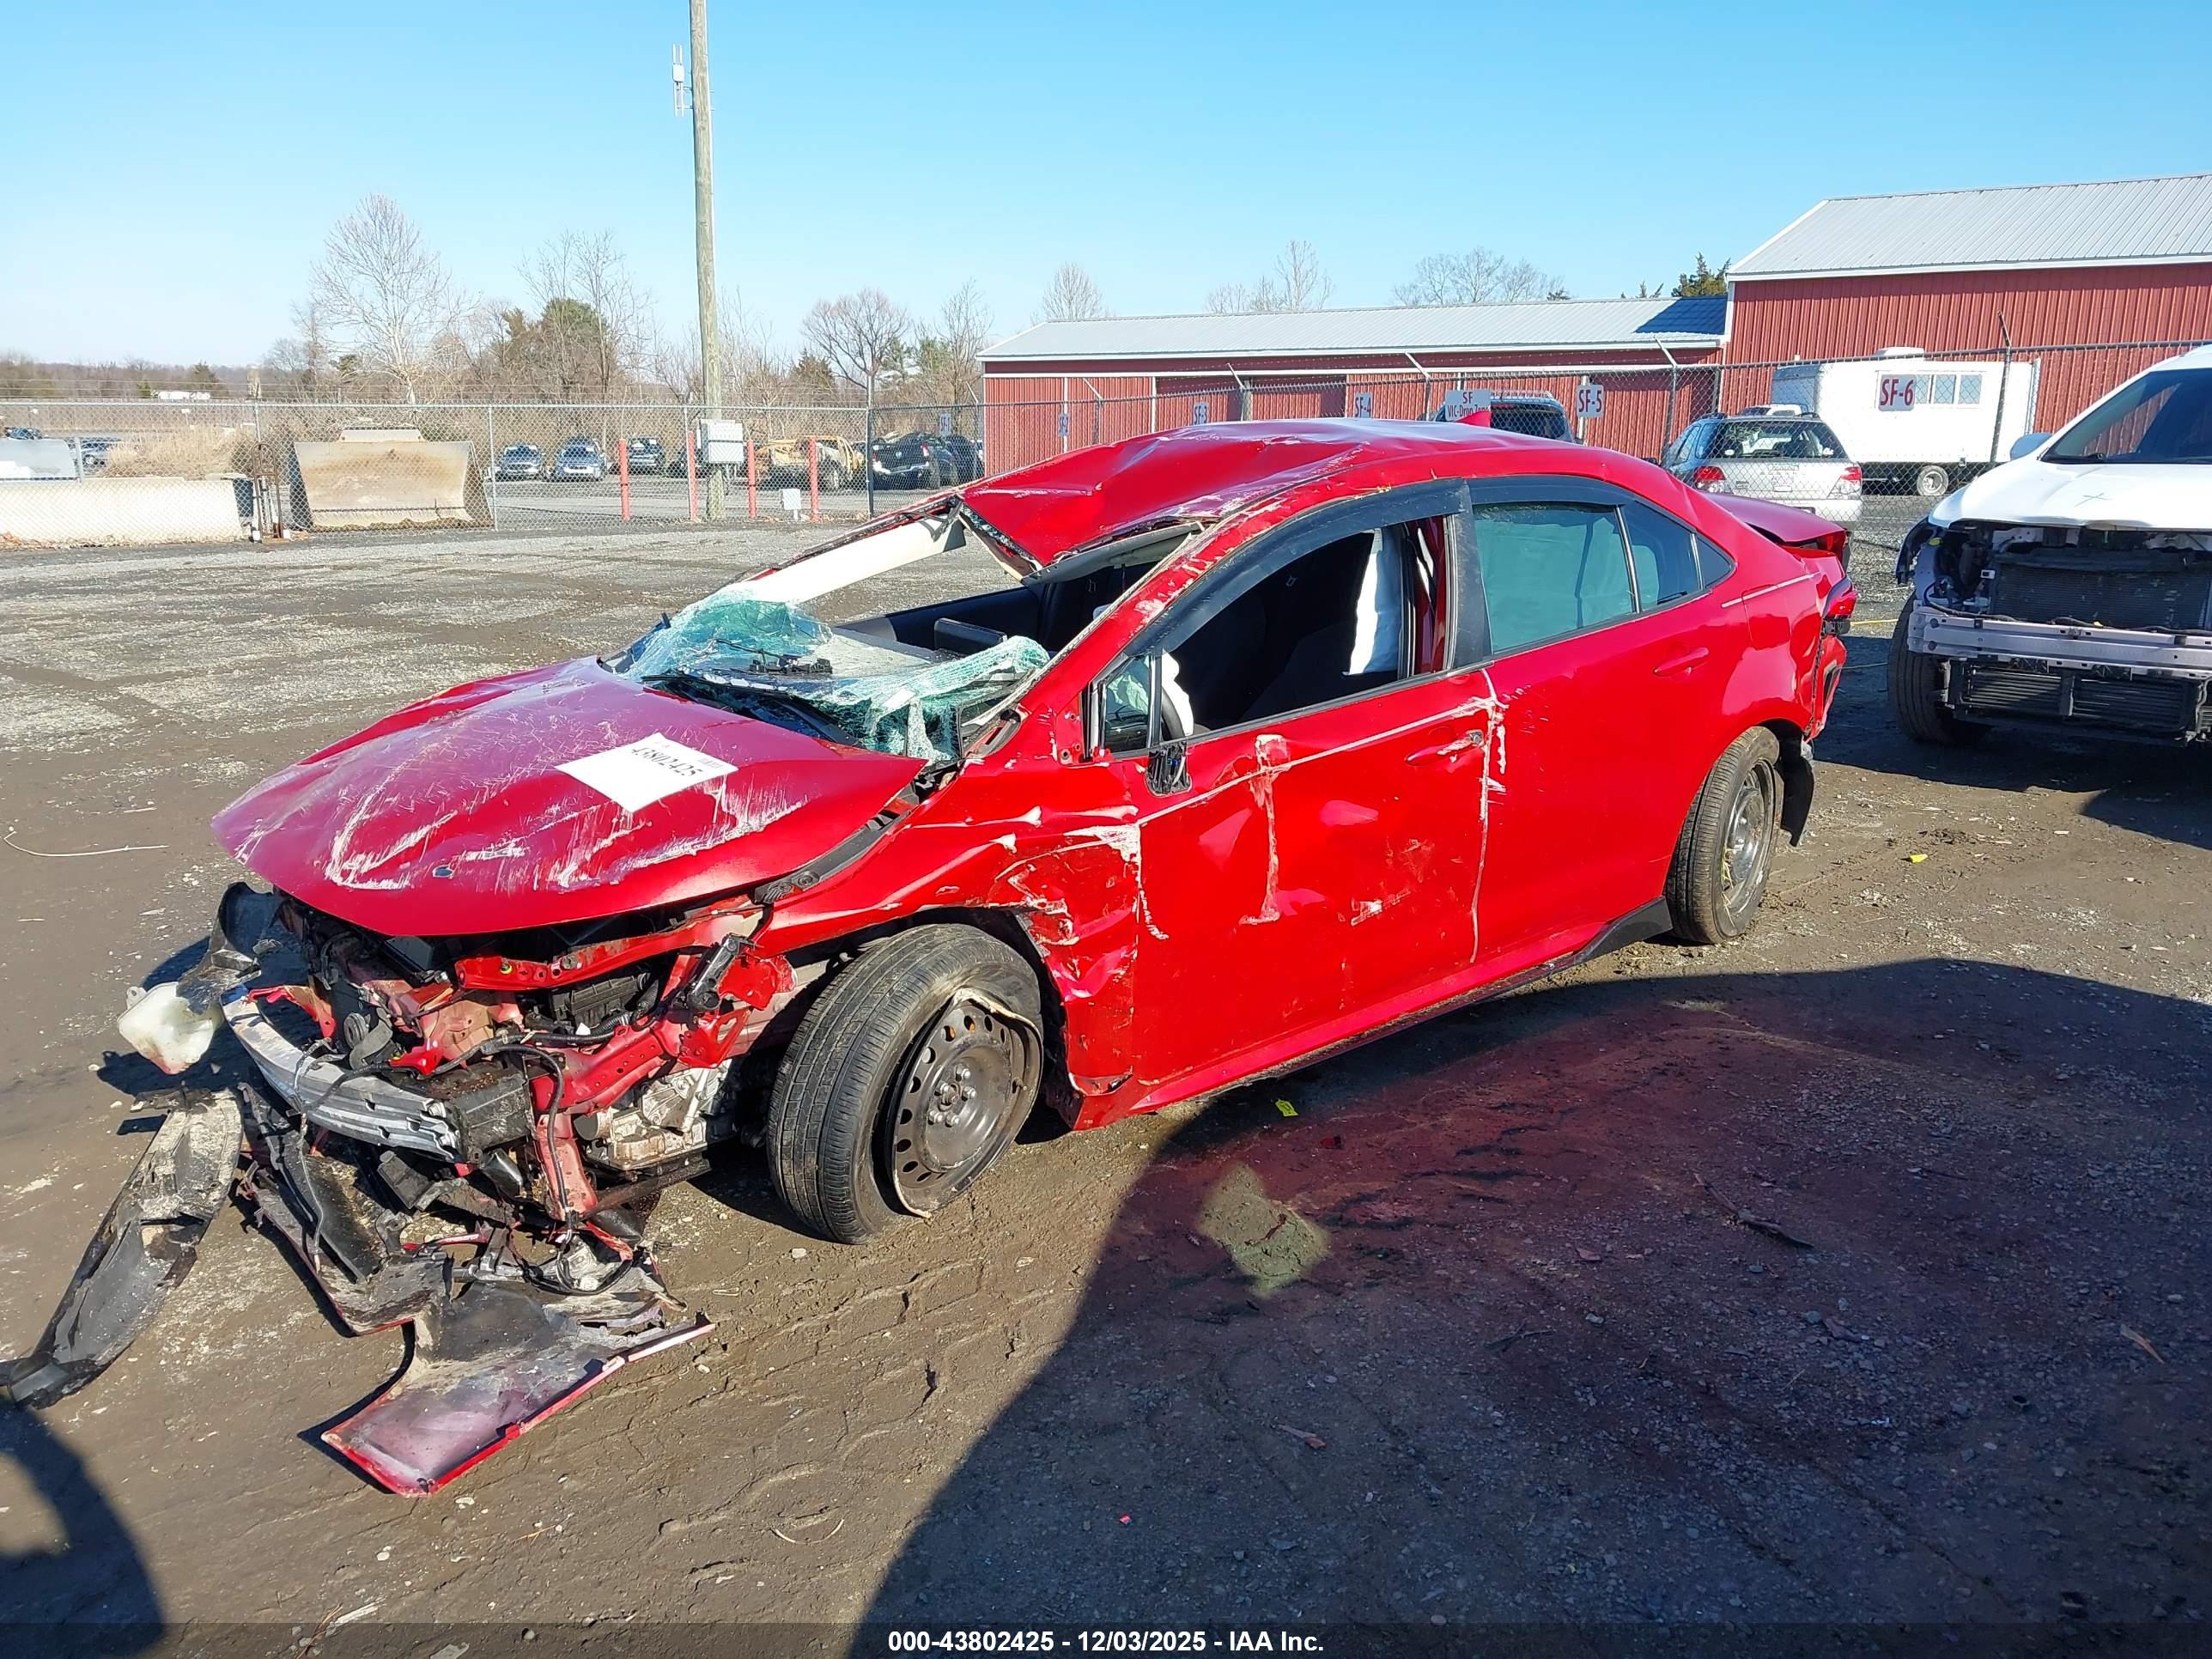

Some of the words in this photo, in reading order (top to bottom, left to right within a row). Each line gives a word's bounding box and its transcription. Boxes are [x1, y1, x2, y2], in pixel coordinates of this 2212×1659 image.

[1462, 392, 1474, 404] SF
[1578, 389, 1602, 412] SF-5
[1881, 379, 1914, 405] SF-6
[1194, 405, 1206, 425] SF-3
[1355, 397, 1371, 417] SF-4
